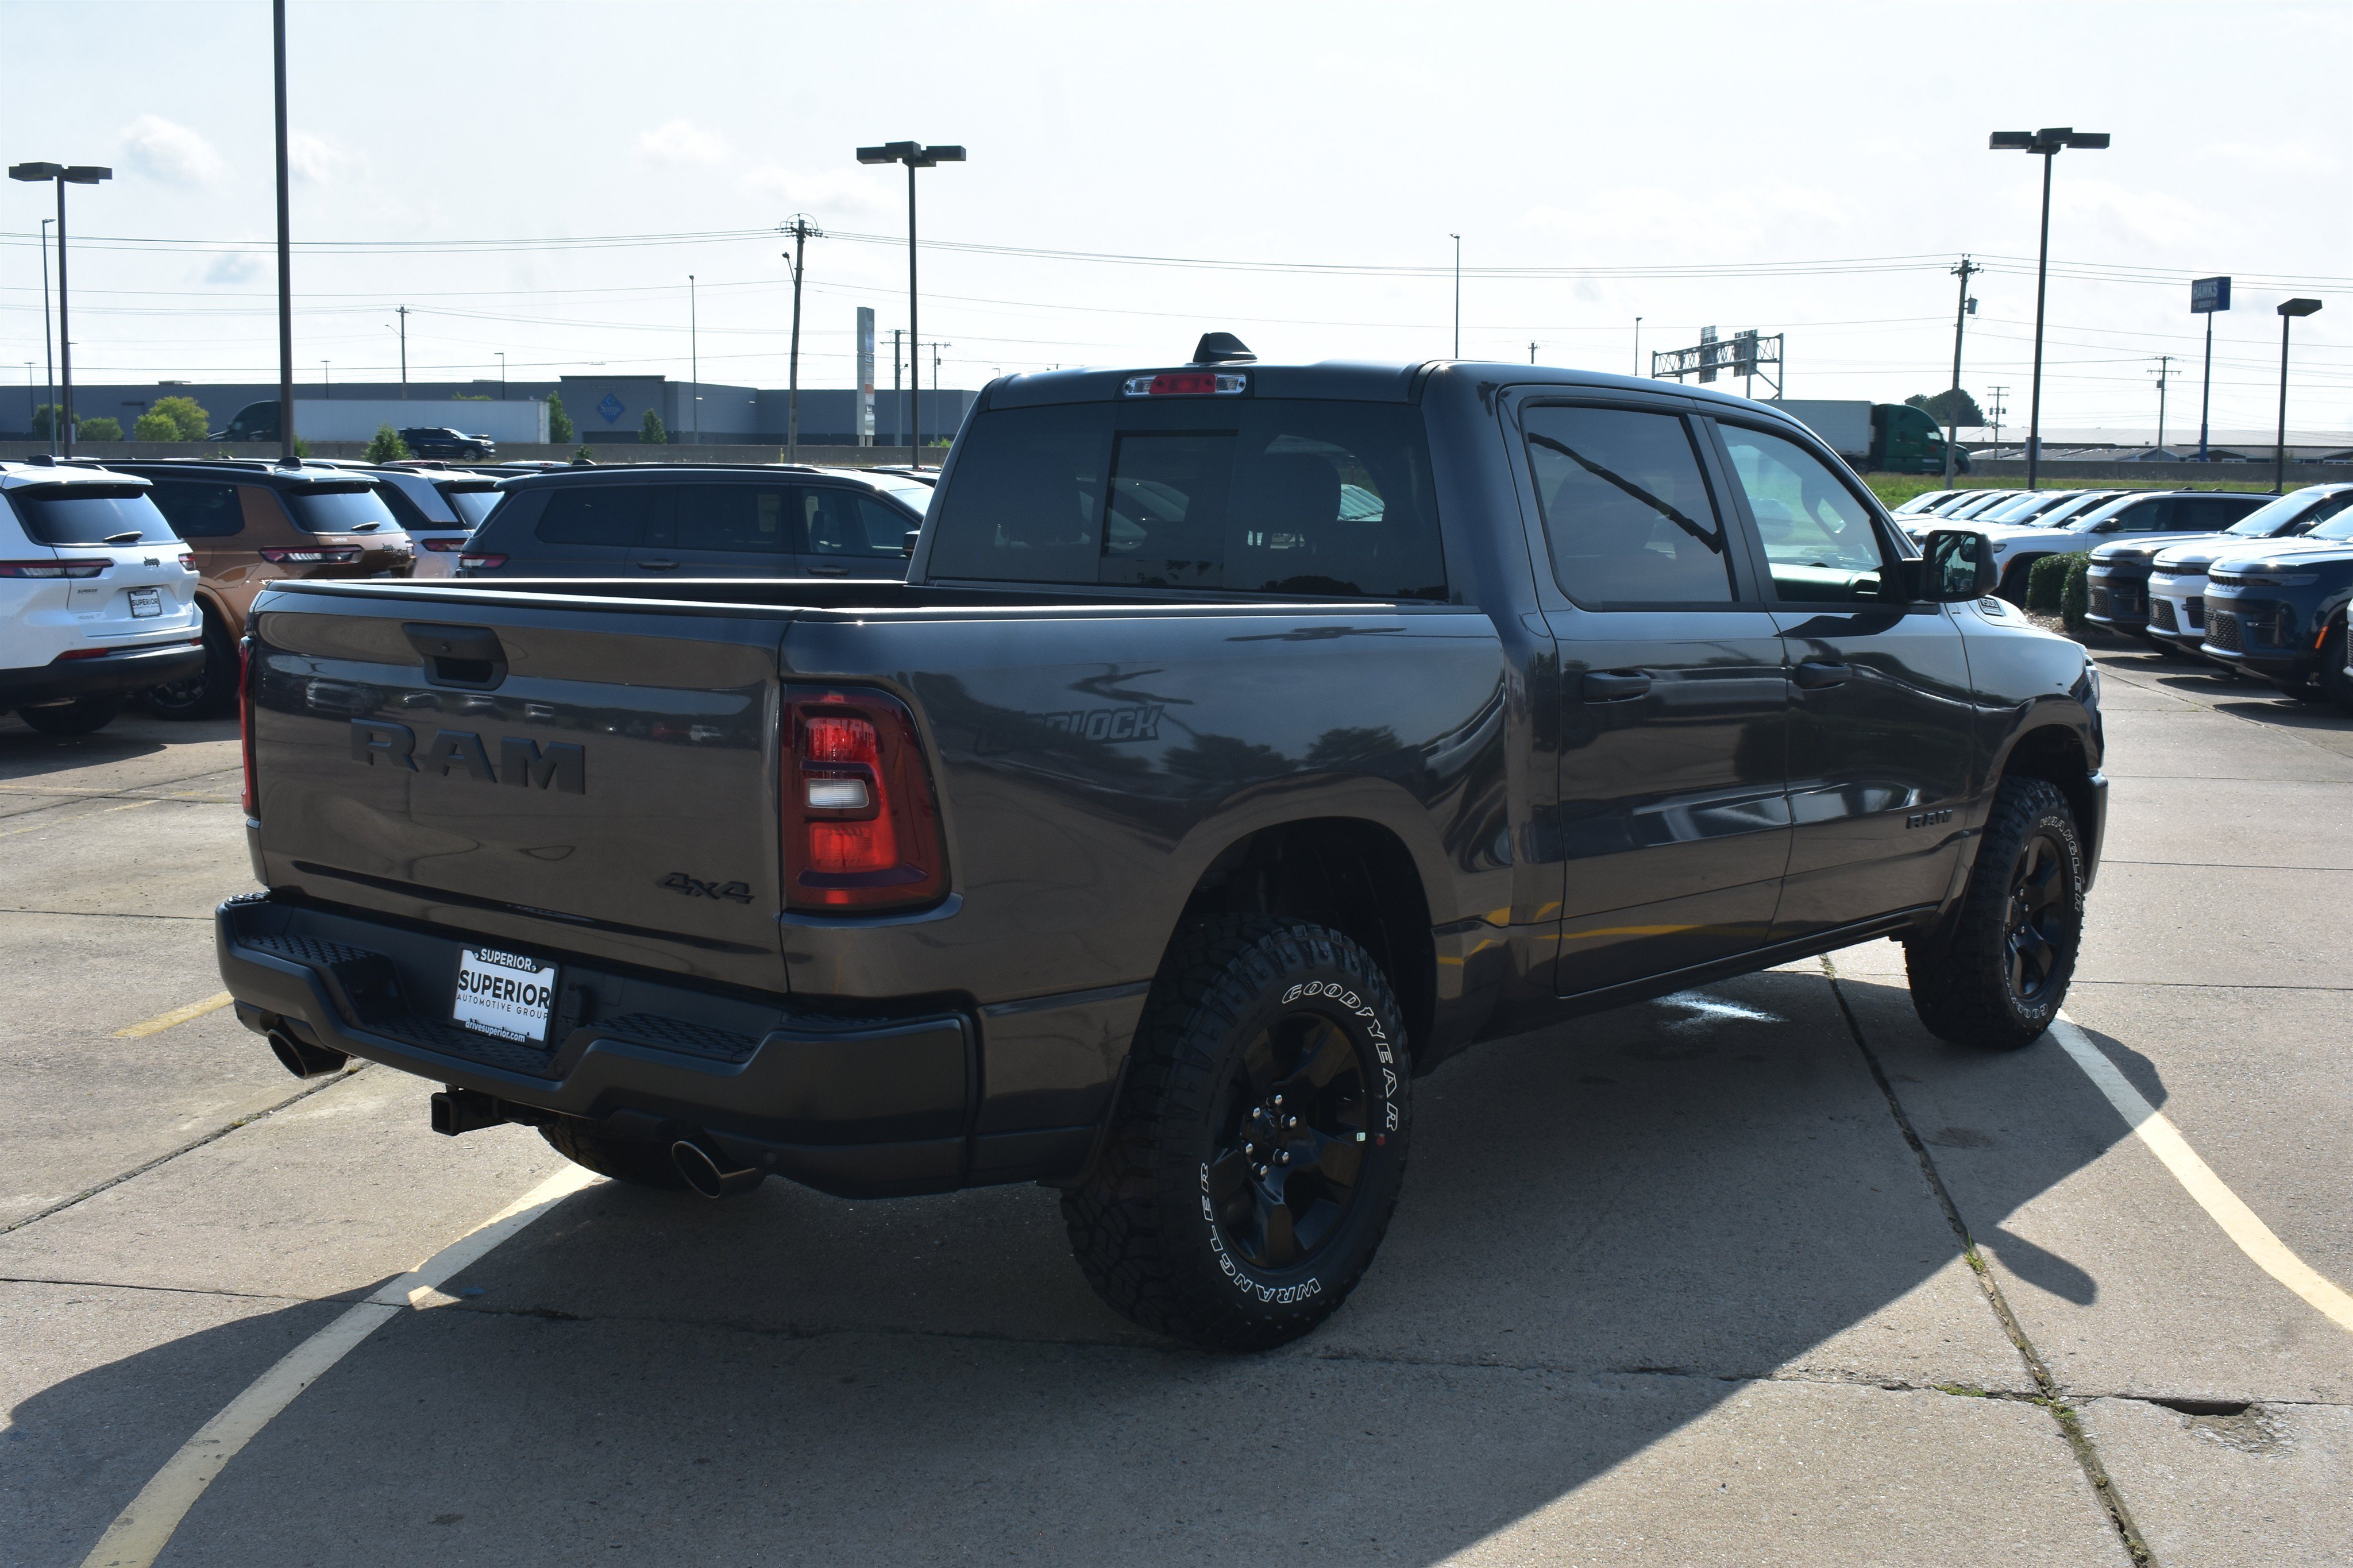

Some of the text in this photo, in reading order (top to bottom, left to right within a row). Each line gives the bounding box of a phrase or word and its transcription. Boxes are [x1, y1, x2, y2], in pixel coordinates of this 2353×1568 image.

[2193, 281, 2217, 300] HAWKS
[144, 557, 160, 567] Jeep
[132, 598, 159, 606] SUPERIOR
[350, 718, 585, 795] RAM
[1906, 809, 1953, 829] RAM
[2040, 816, 2082, 912] WRANGLER
[480, 948, 533, 971] SUPERIOR
[458, 969, 551, 1009] SUPERIOR
[456, 993, 549, 1020] AUTOMOTIVE GROUP
[465, 1019, 526, 1043] drivesuperior.com
[1282, 980, 1399, 1131] GOODYEAR
[1200, 1163, 1321, 1303] WRANGLER
